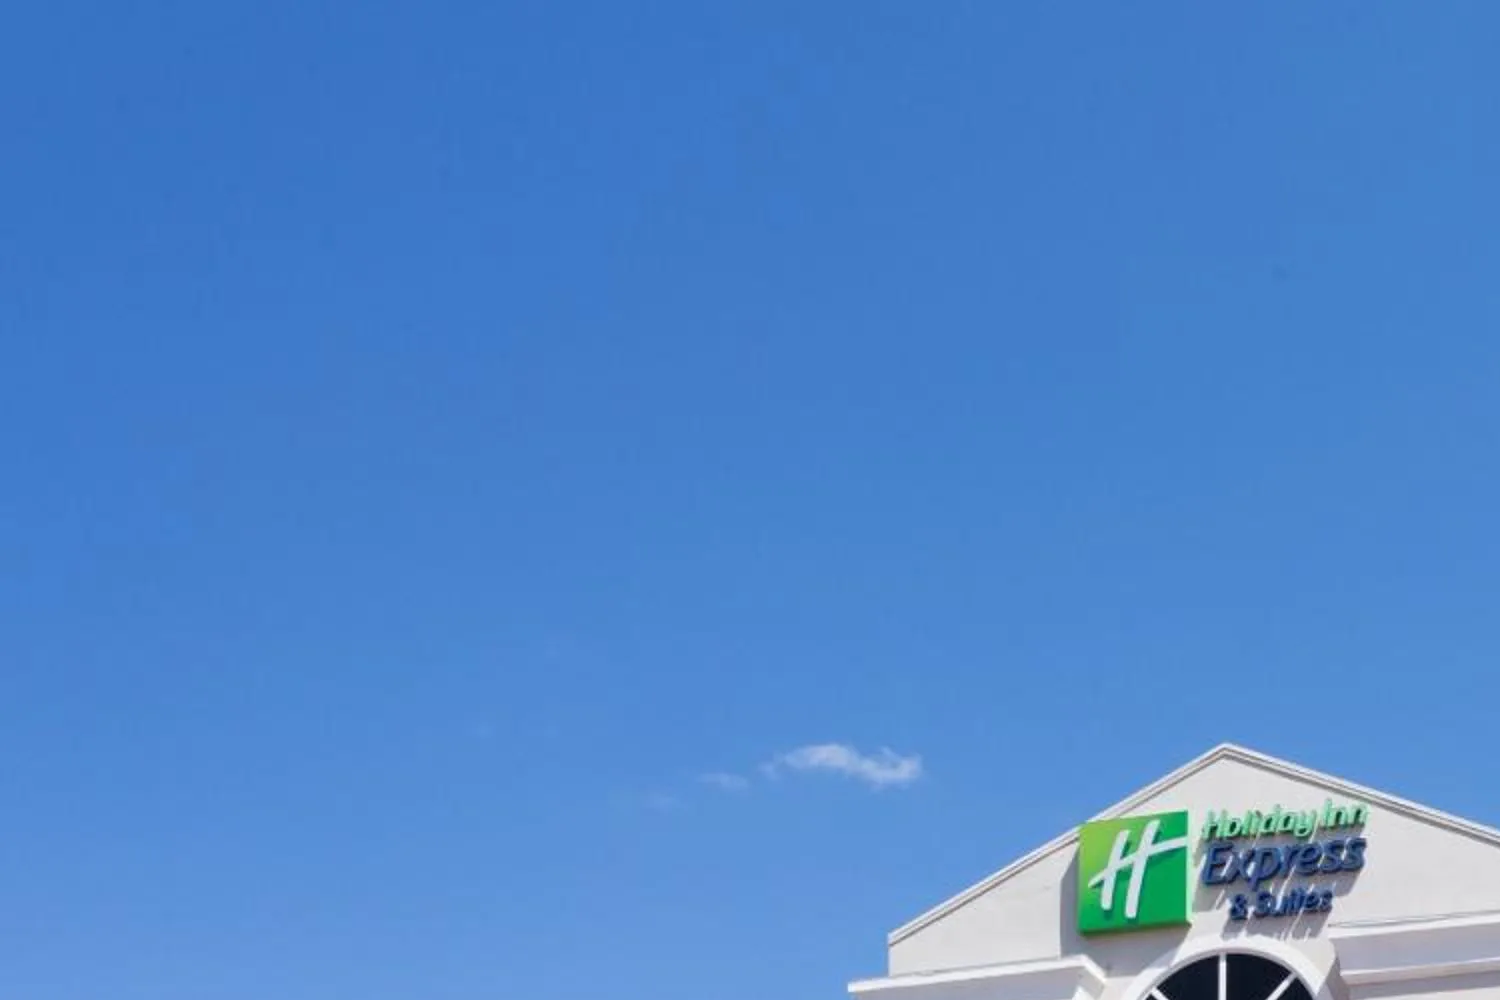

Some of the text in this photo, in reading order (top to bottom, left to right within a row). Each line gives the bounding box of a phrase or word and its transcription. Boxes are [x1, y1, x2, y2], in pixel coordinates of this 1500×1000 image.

[1201, 798, 1369, 840] Holiday Inn
[1203, 837, 1367, 891] Express
[1229, 887, 1333, 920] & Suites
